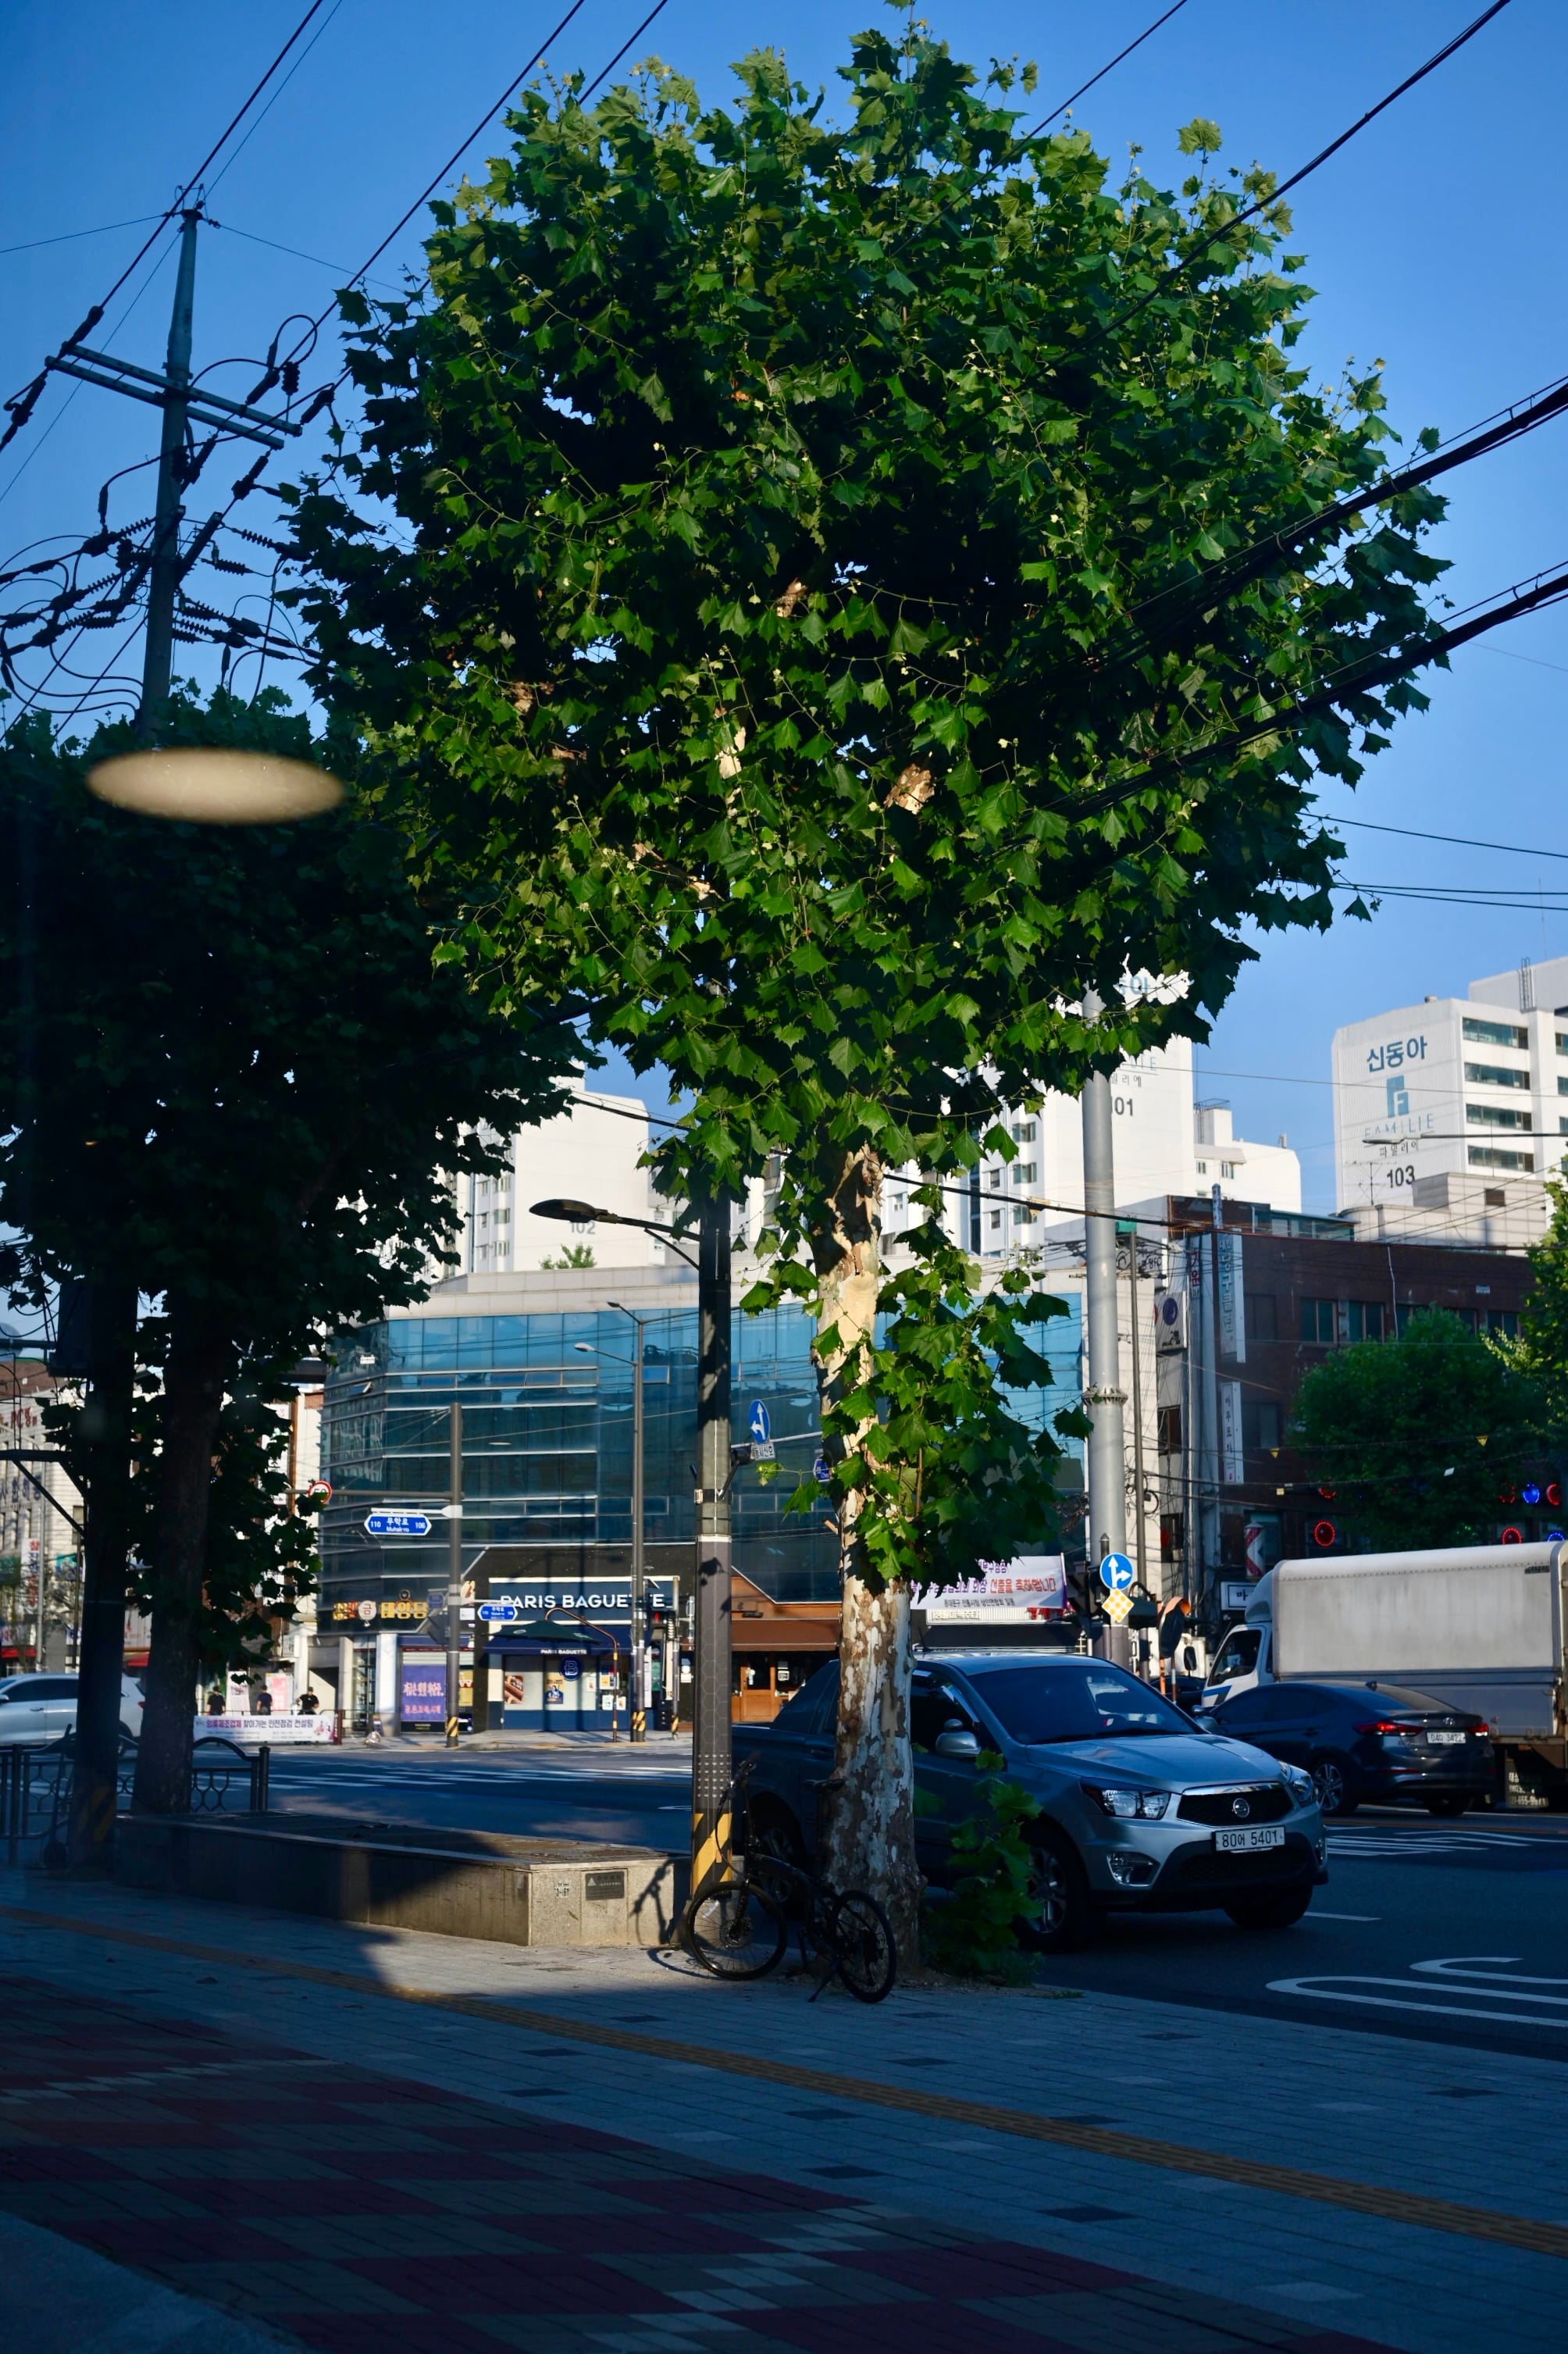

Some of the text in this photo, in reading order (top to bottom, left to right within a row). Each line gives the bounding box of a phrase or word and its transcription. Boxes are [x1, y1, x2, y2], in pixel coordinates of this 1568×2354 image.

[1367, 1036, 1427, 1073] 신동아
[1114, 1097, 1134, 1117] 01
[1365, 1114, 1434, 1137] FAMILIE
[1386, 1165, 1416, 1189] 103
[387, 1517, 409, 1526] 무학로
[990, 1578, 1013, 1594] 선출을
[1016, 1577, 1057, 1593] 축하합니다
[562, 1594, 665, 1608] BAGUEE
[362, 1603, 372, 1615] 금
[380, 1602, 428, 1619] 태양당
[243, 1720, 268, 1728] 찾아가는
[268, 1720, 293, 1728] 안전점검
[1222, 1830, 1278, 1848] 80어 5401
